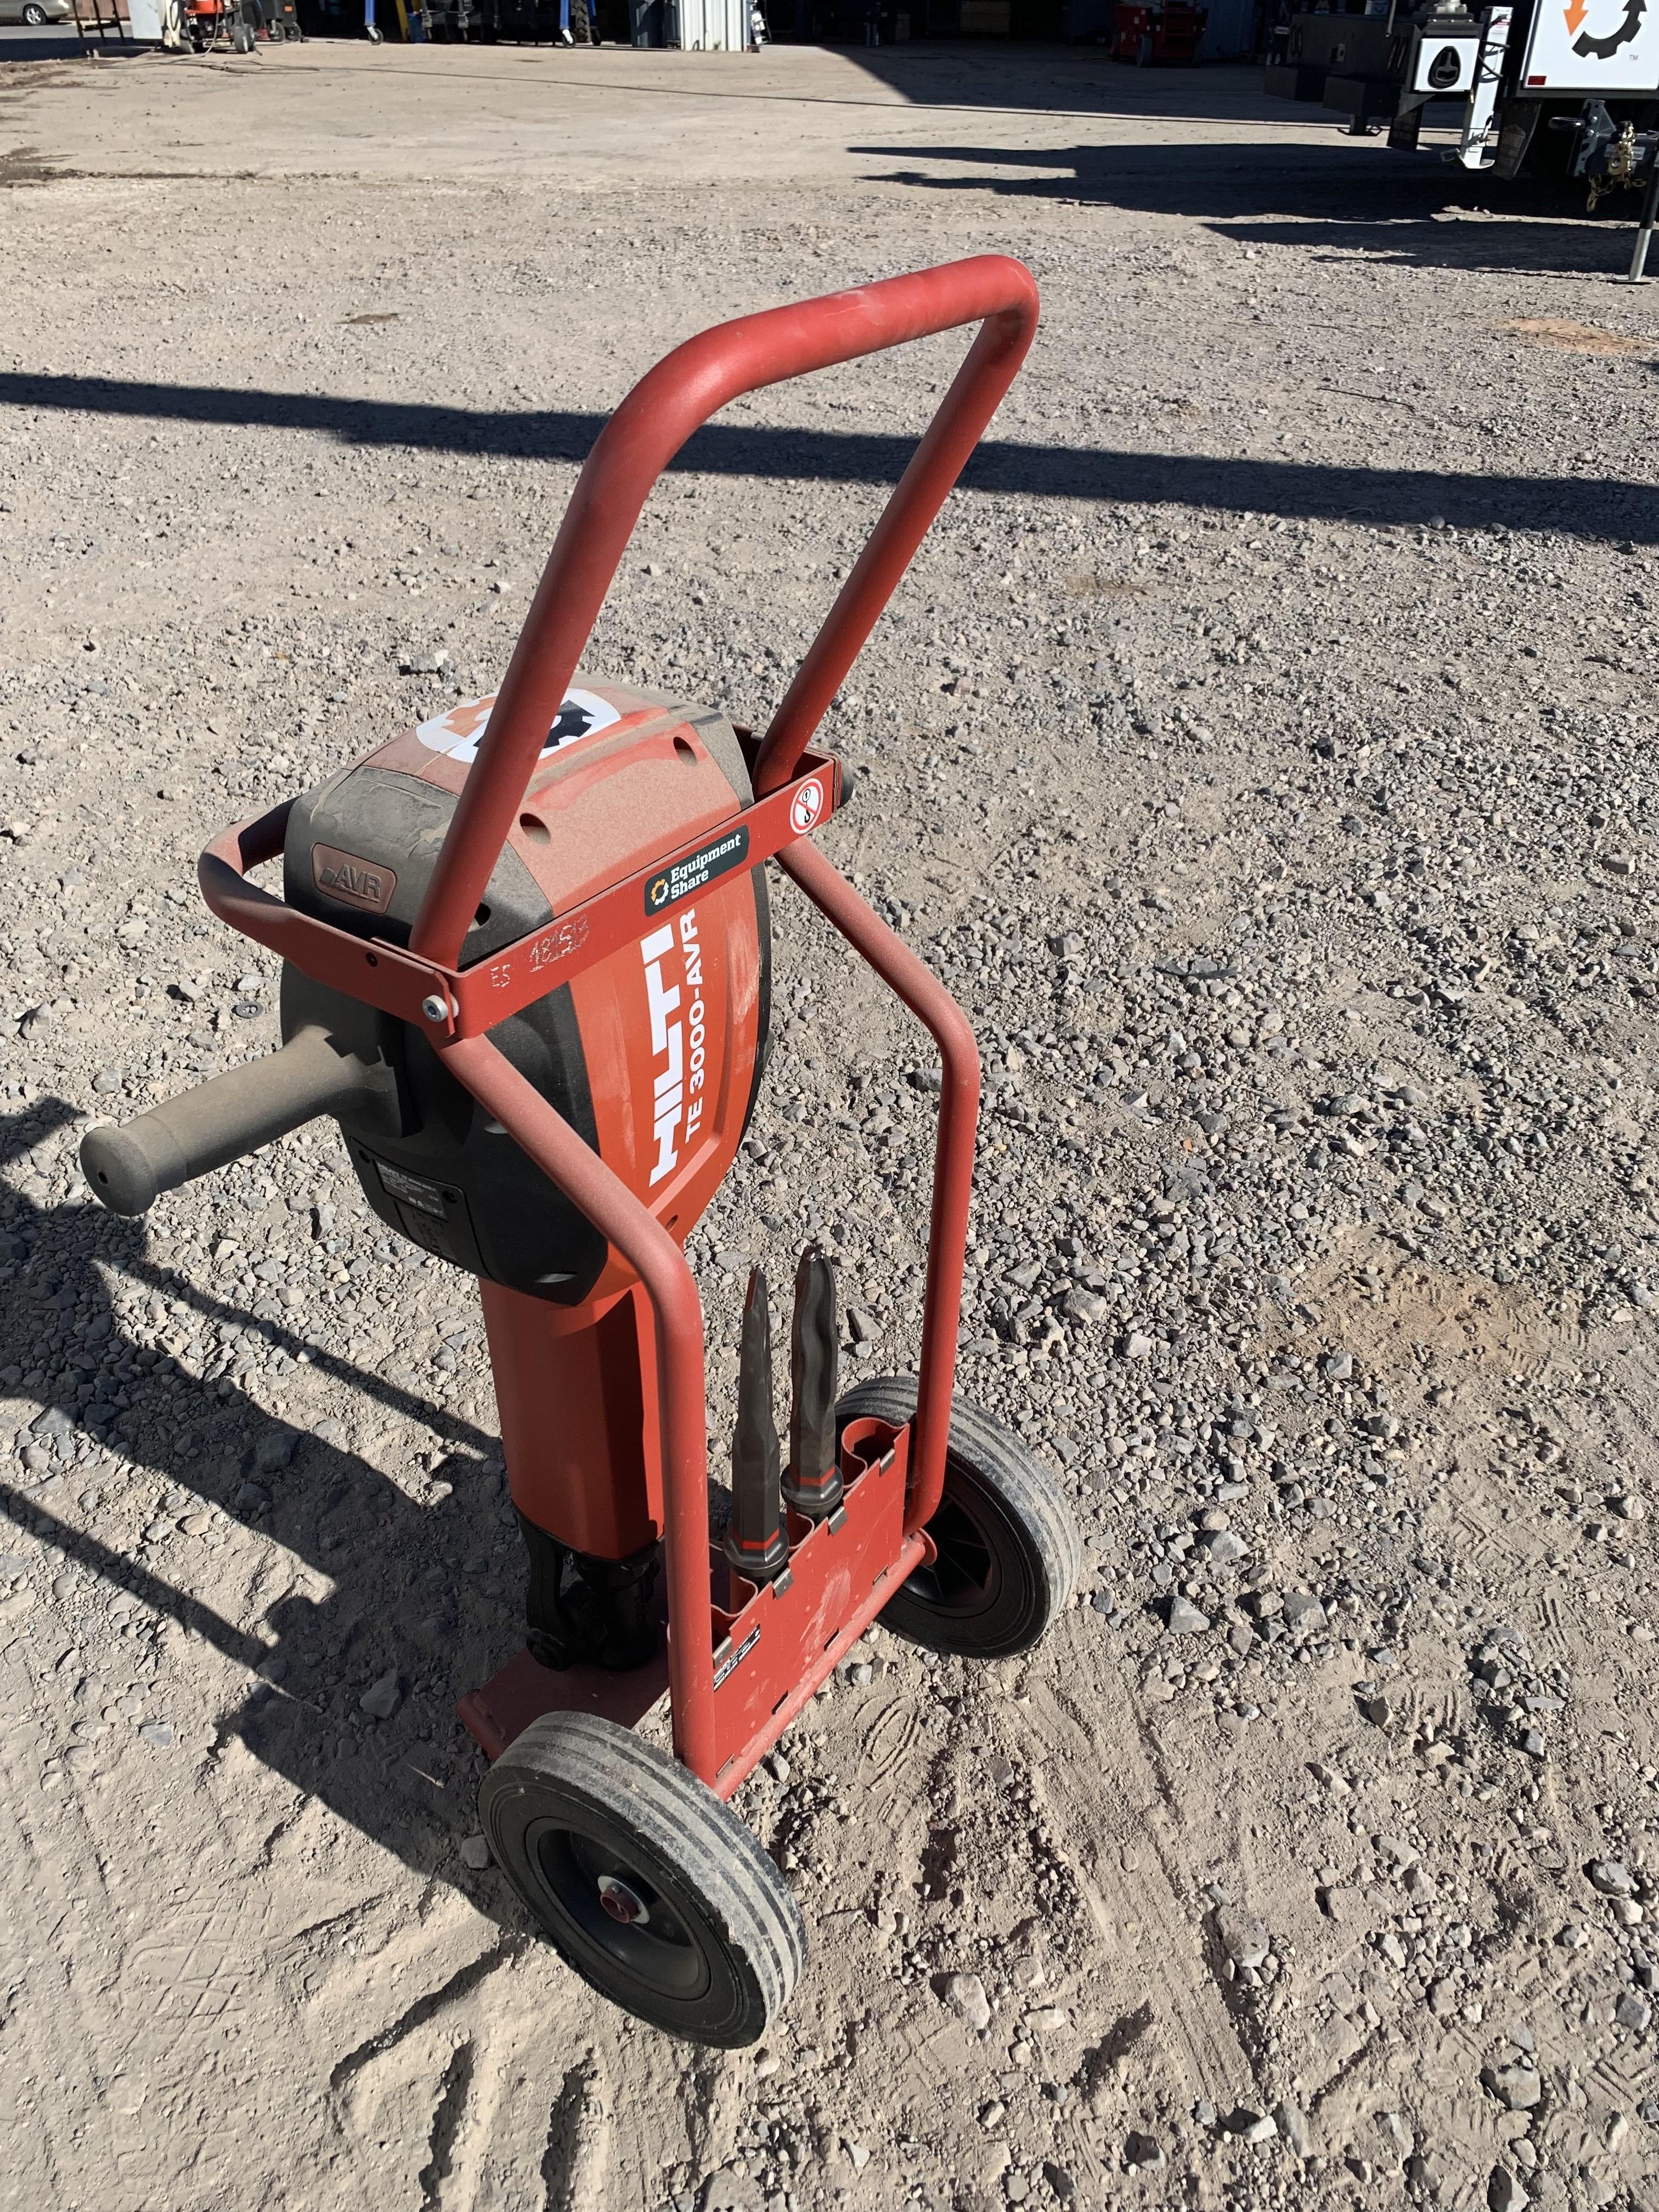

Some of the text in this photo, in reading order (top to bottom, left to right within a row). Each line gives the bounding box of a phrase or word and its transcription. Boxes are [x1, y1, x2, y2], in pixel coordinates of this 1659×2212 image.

[335, 864, 382, 899] AVR
[670, 834, 741, 884] Equipment
[670, 870, 709, 899] Share
[679, 908, 705, 1144] TE 3000-AVR
[640, 923, 684, 1188] HILTI
